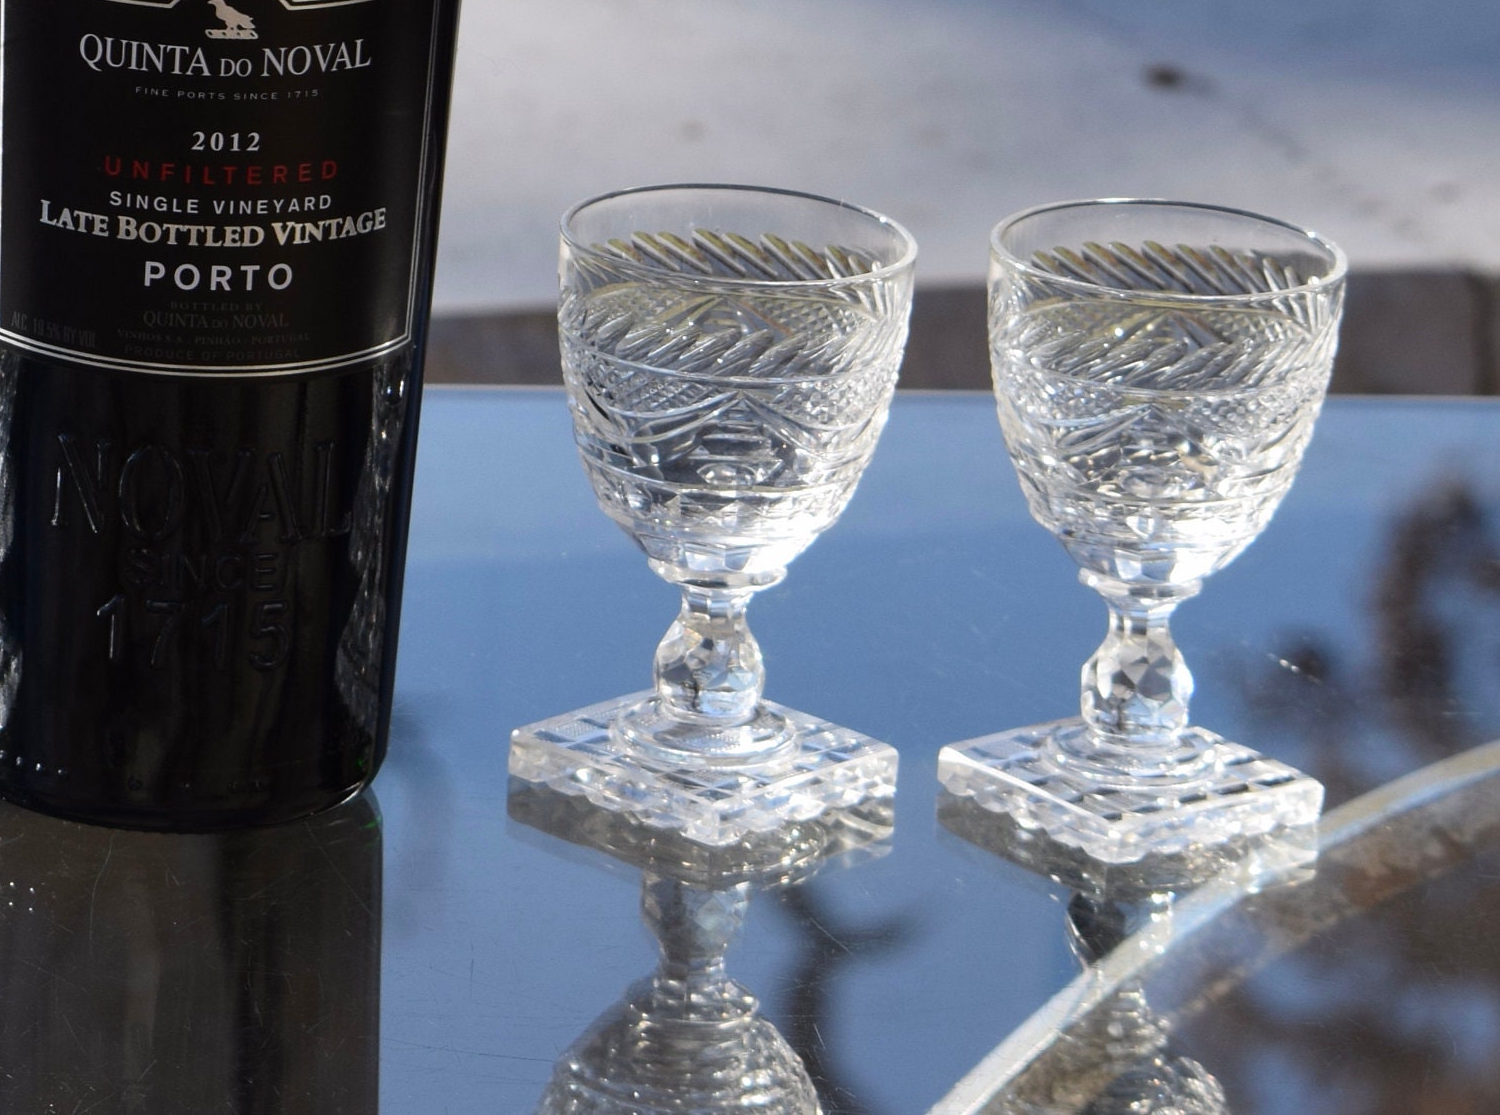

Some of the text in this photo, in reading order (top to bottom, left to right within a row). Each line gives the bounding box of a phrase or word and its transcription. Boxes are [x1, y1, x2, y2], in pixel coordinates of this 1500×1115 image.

[79, 33, 371, 77] QUINTA DO NOVAL
[135, 86, 319, 100] FINE PORTS SINCE 1715
[190, 131, 261, 152] 2012
[103, 154, 338, 185] UNFILTERED
[109, 190, 332, 215] SINGLE VINEYARD
[39, 199, 387, 248] LATE BOTTLED VINTAGE
[144, 260, 293, 291] PORTO
[143, 310, 289, 329] QUINTA DO NOVAL
[169, 300, 262, 311] BOTTLED BY
[124, 344, 302, 361] PRODUCE OF PORTUGAL
[50, 432, 353, 545] NOVAL
[96, 594, 290, 672] 1715
